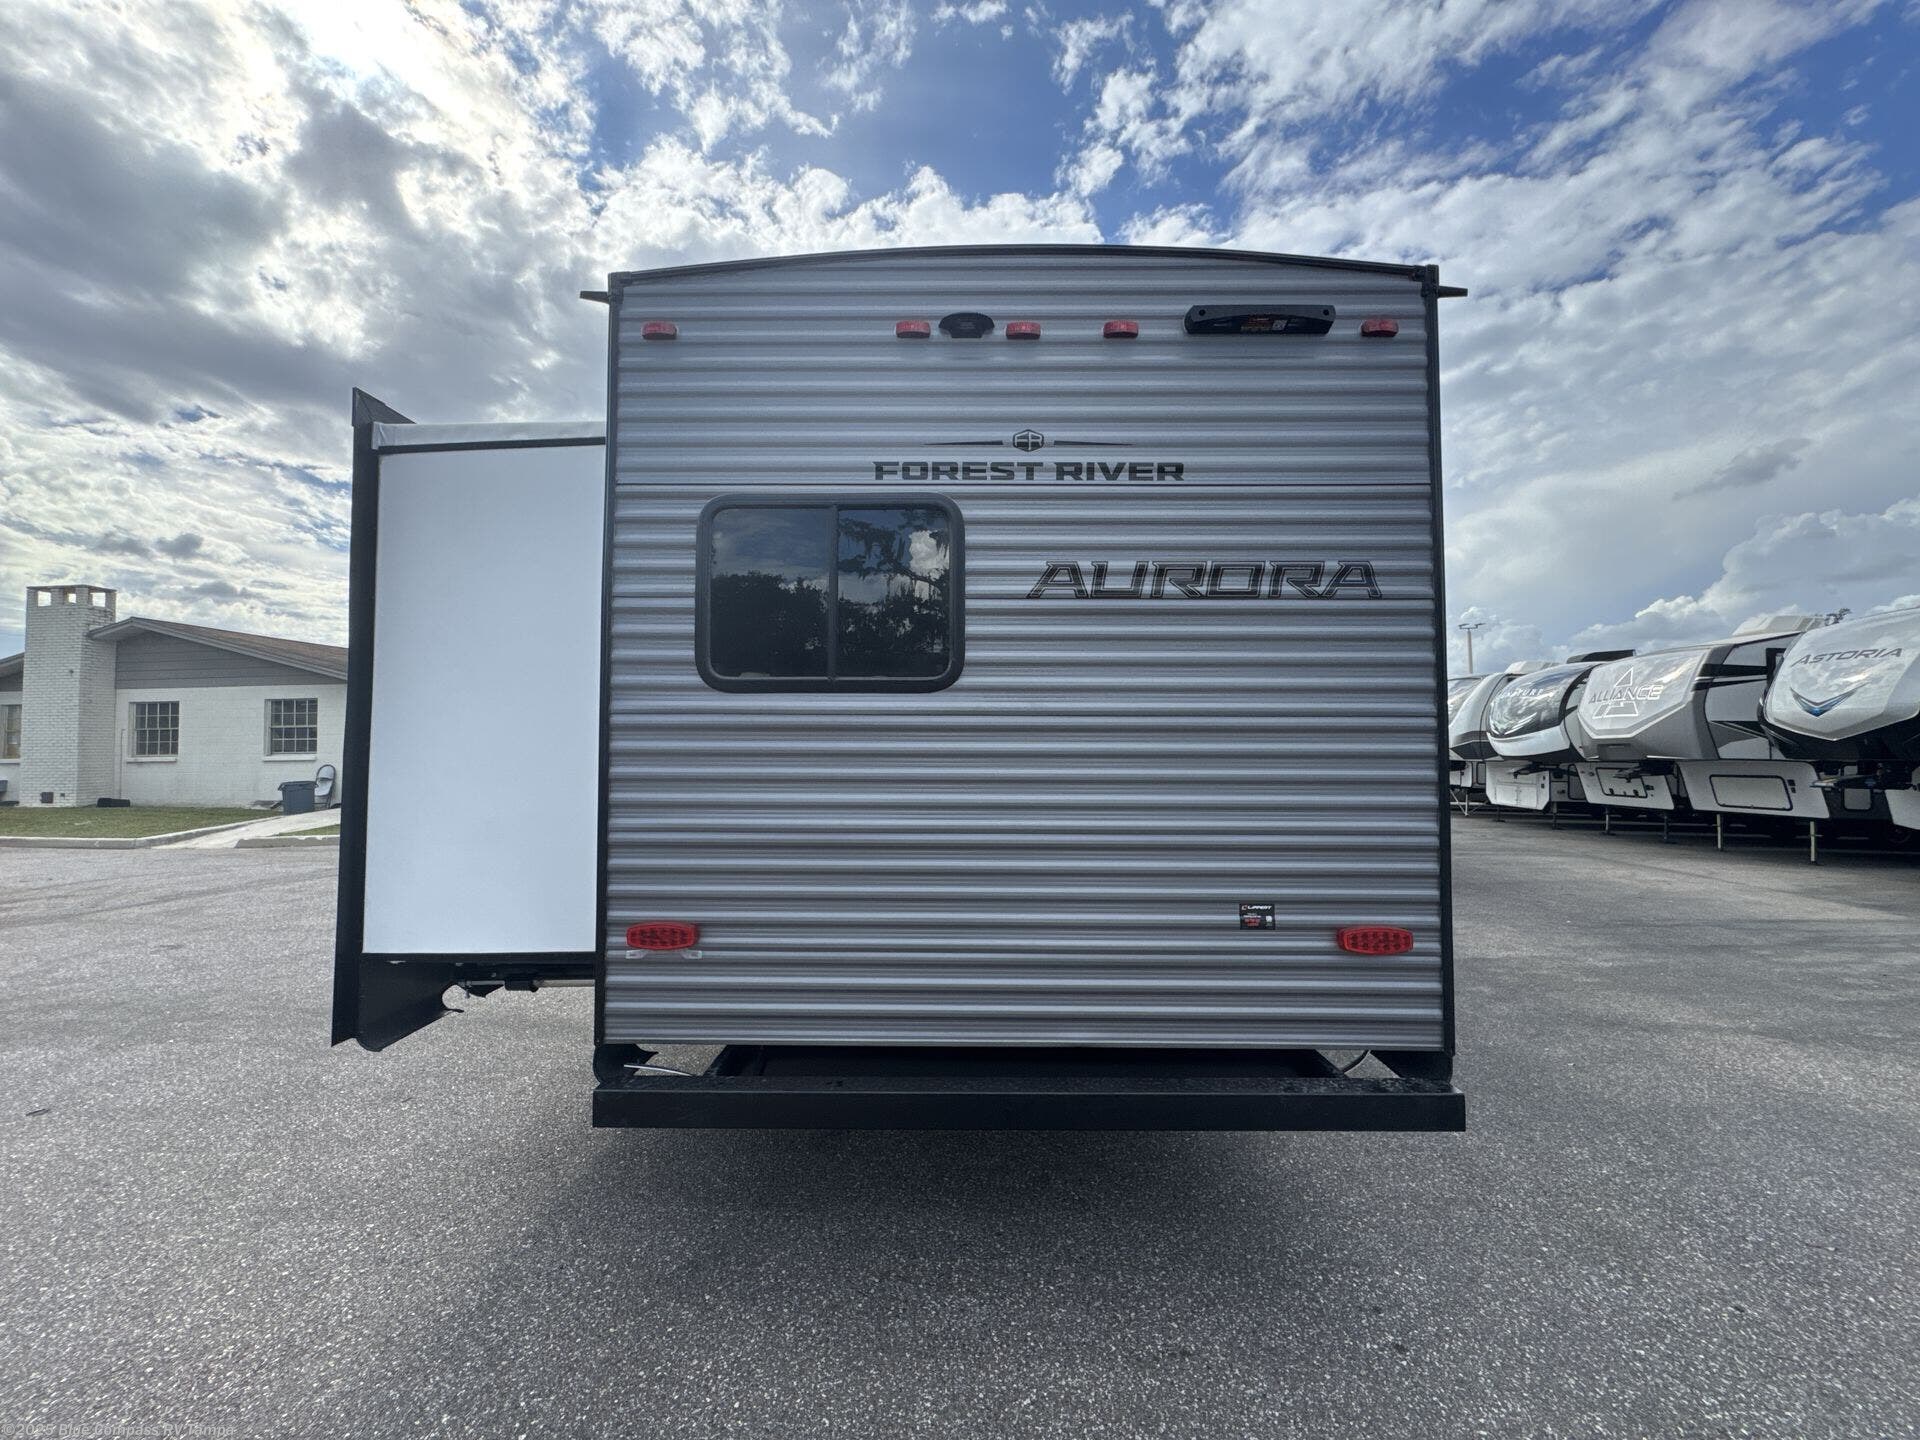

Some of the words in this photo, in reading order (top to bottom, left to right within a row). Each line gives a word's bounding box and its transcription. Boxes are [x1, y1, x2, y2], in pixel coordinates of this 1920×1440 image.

[873, 461, 1043, 481] FOREST
[1055, 461, 1185, 481] RIVER
[1026, 560, 1382, 599] AURORA
[1790, 647, 1903, 668] ASTORIA
[1588, 684, 1664, 705] ALLIANCE
